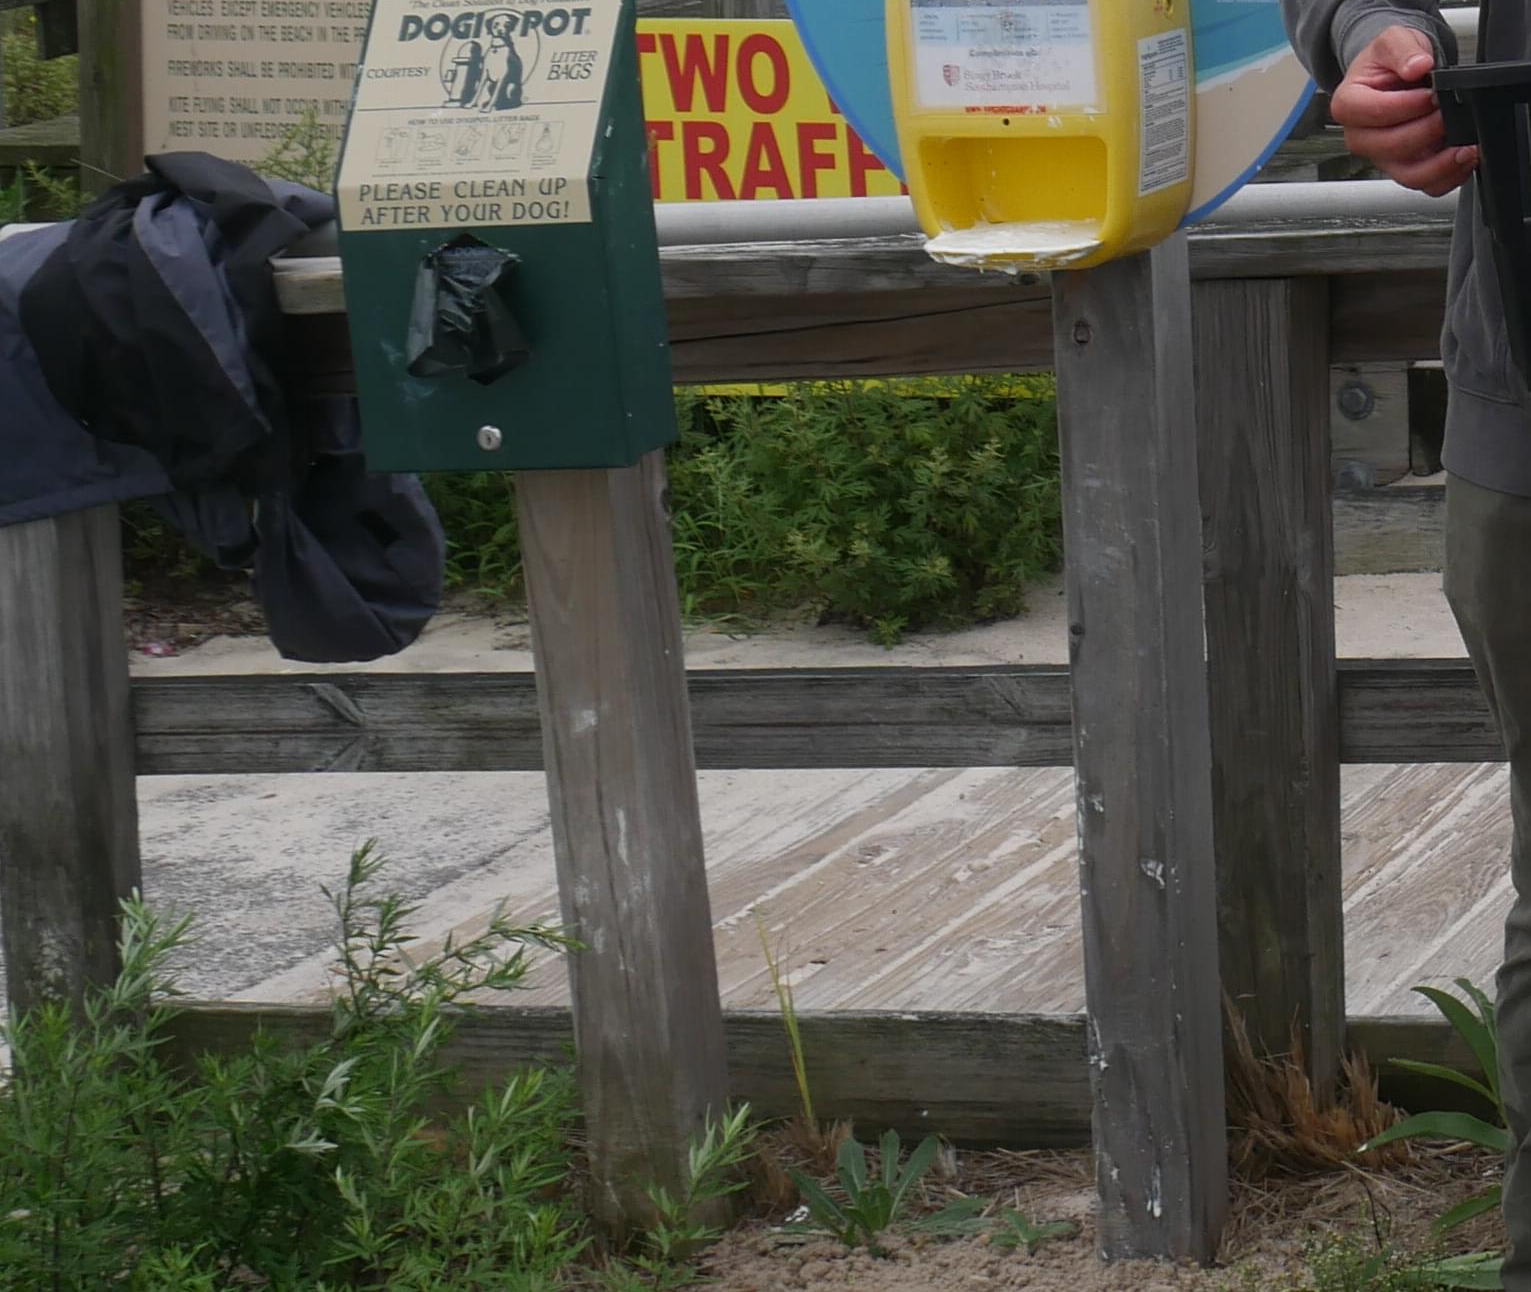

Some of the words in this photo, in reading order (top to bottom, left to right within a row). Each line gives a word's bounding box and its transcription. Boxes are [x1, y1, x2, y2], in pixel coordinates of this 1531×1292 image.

[551, 51, 597, 63] LITTER
[366, 67, 431, 79] COURTESY
[548, 63, 592, 80] BAGS
[359, 182, 442, 202] PLEASE
[454, 179, 526, 198] CLEAN
[539, 178, 567, 196] UP
[361, 207, 430, 225] AFTER
[440, 203, 502, 222] YOUR
[512, 201, 569, 219] DOG!
